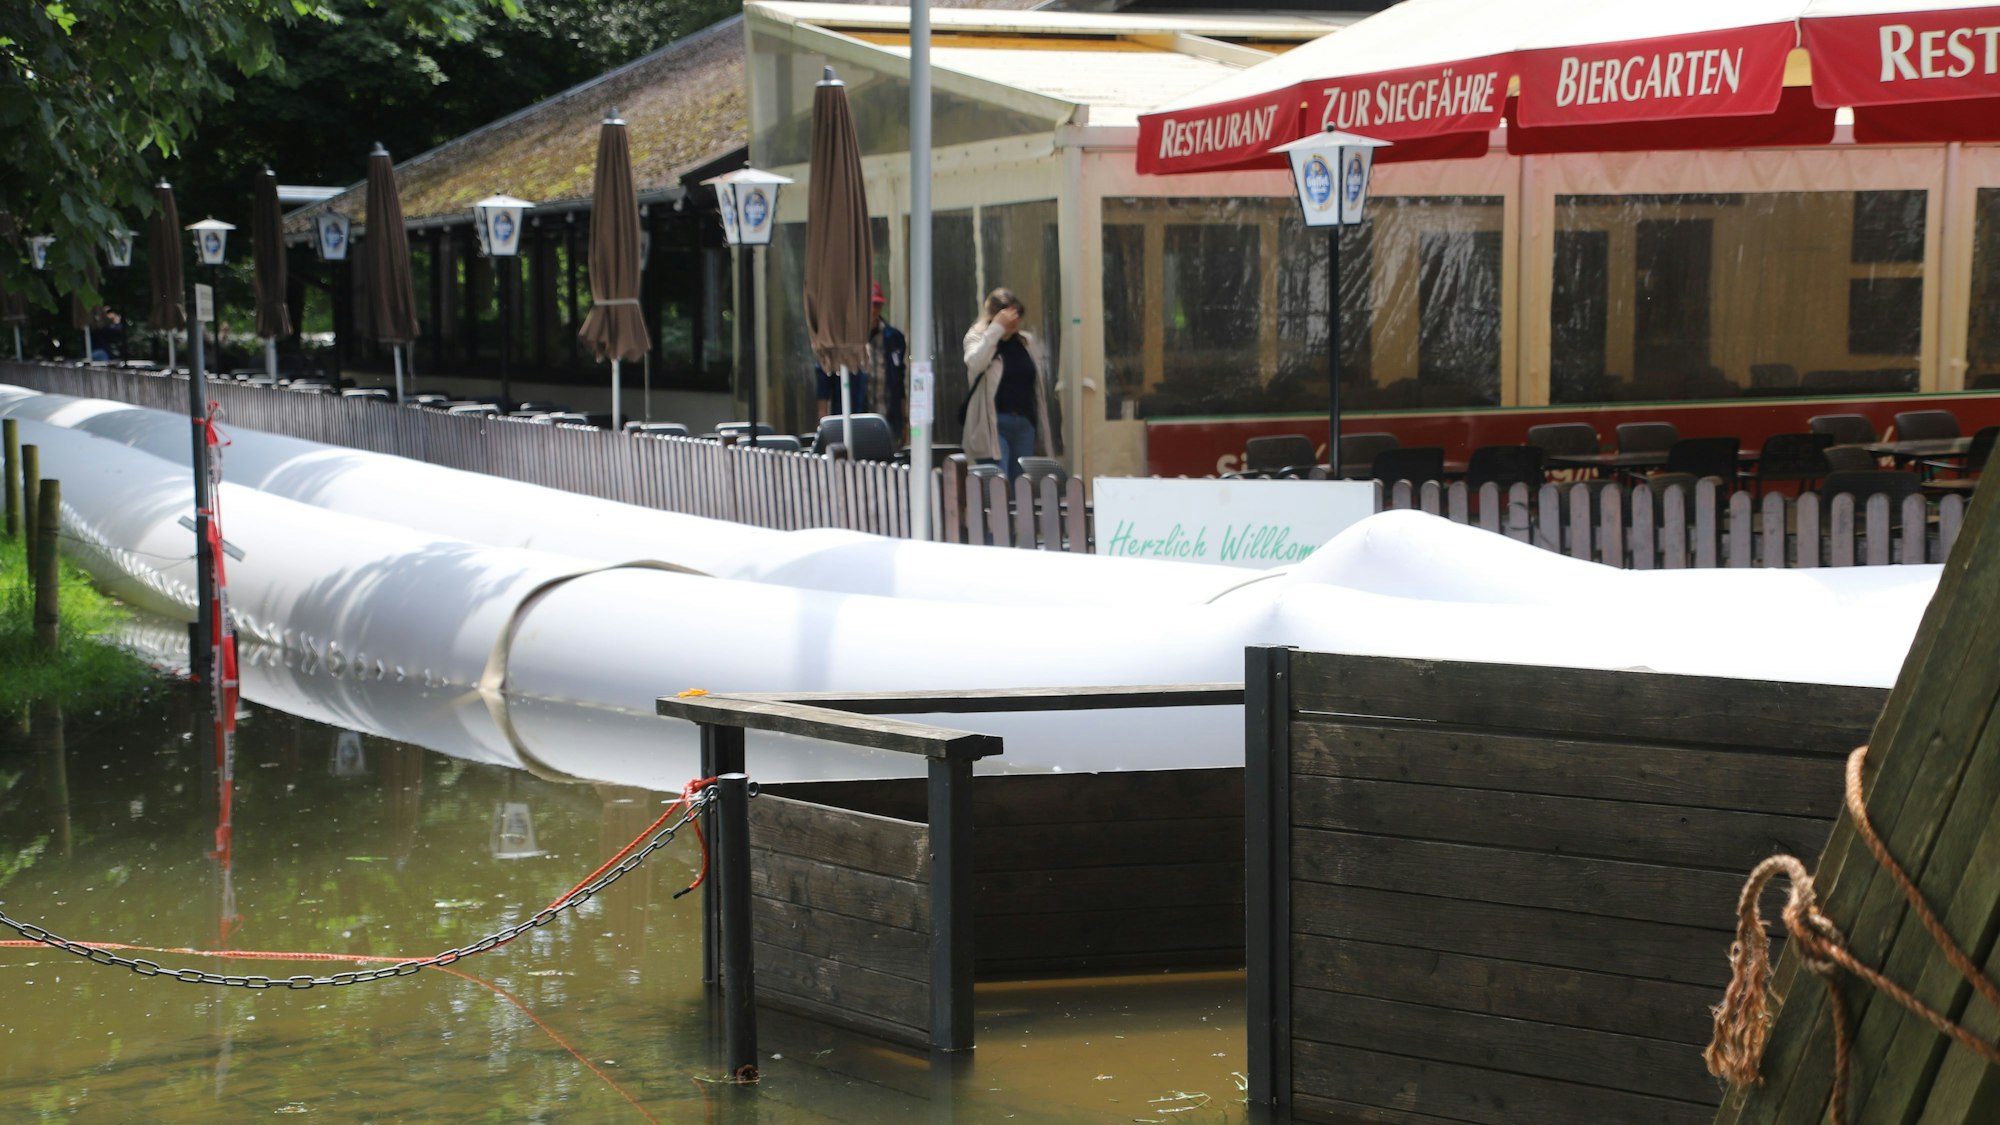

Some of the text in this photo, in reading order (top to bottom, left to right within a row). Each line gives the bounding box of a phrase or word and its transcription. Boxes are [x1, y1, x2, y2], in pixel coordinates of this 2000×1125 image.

[1321, 68, 1498, 131] ZUR SIEGFÄHRE
[1556, 47, 1743, 107] BIERGARTEN
[1159, 104, 1279, 159] RESTAURANT
[1108, 519, 1322, 561] Herzlich Willkom
